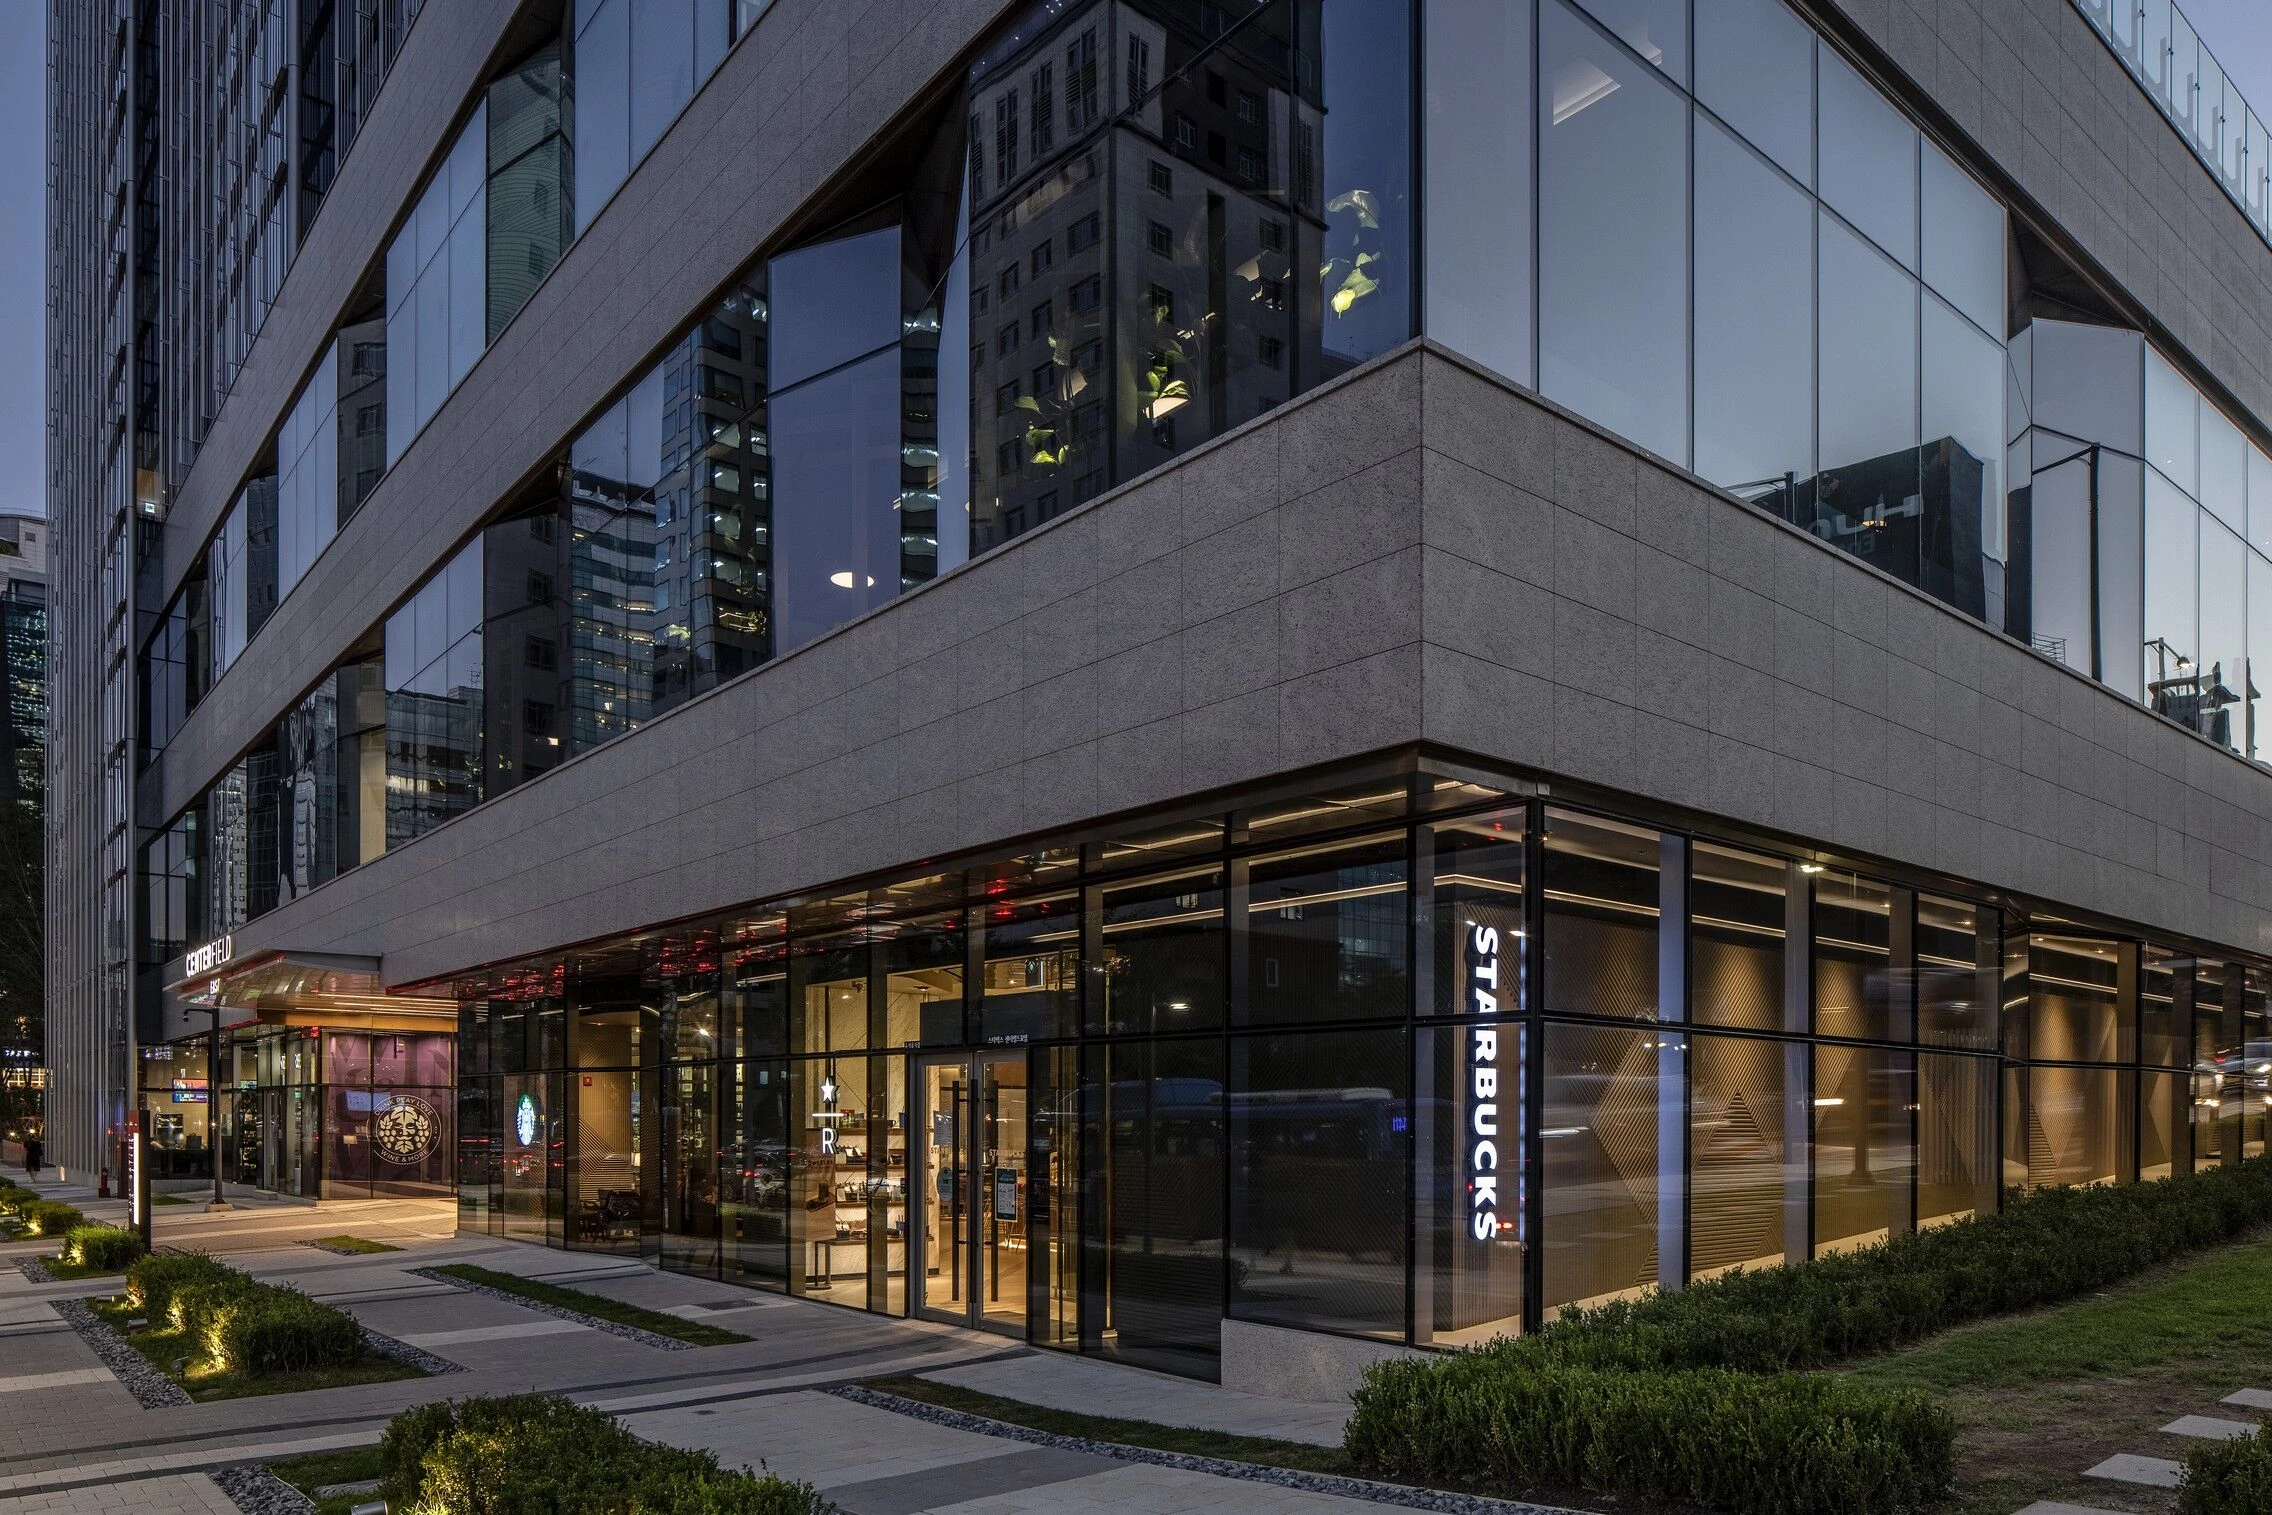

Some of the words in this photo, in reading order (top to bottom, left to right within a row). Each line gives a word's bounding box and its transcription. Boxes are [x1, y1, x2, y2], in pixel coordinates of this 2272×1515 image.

[186, 935, 231, 977] CENTERFIELD
[210, 978, 220, 994] EAST
[1474, 925, 1498, 1240] STARBUCKS
[374, 1099, 395, 1116] DRINK
[416, 1101, 434, 1116] LOVE
[822, 1127, 836, 1155] R
[381, 1149, 401, 1162] WINE
[407, 1148, 429, 1162] MORE
